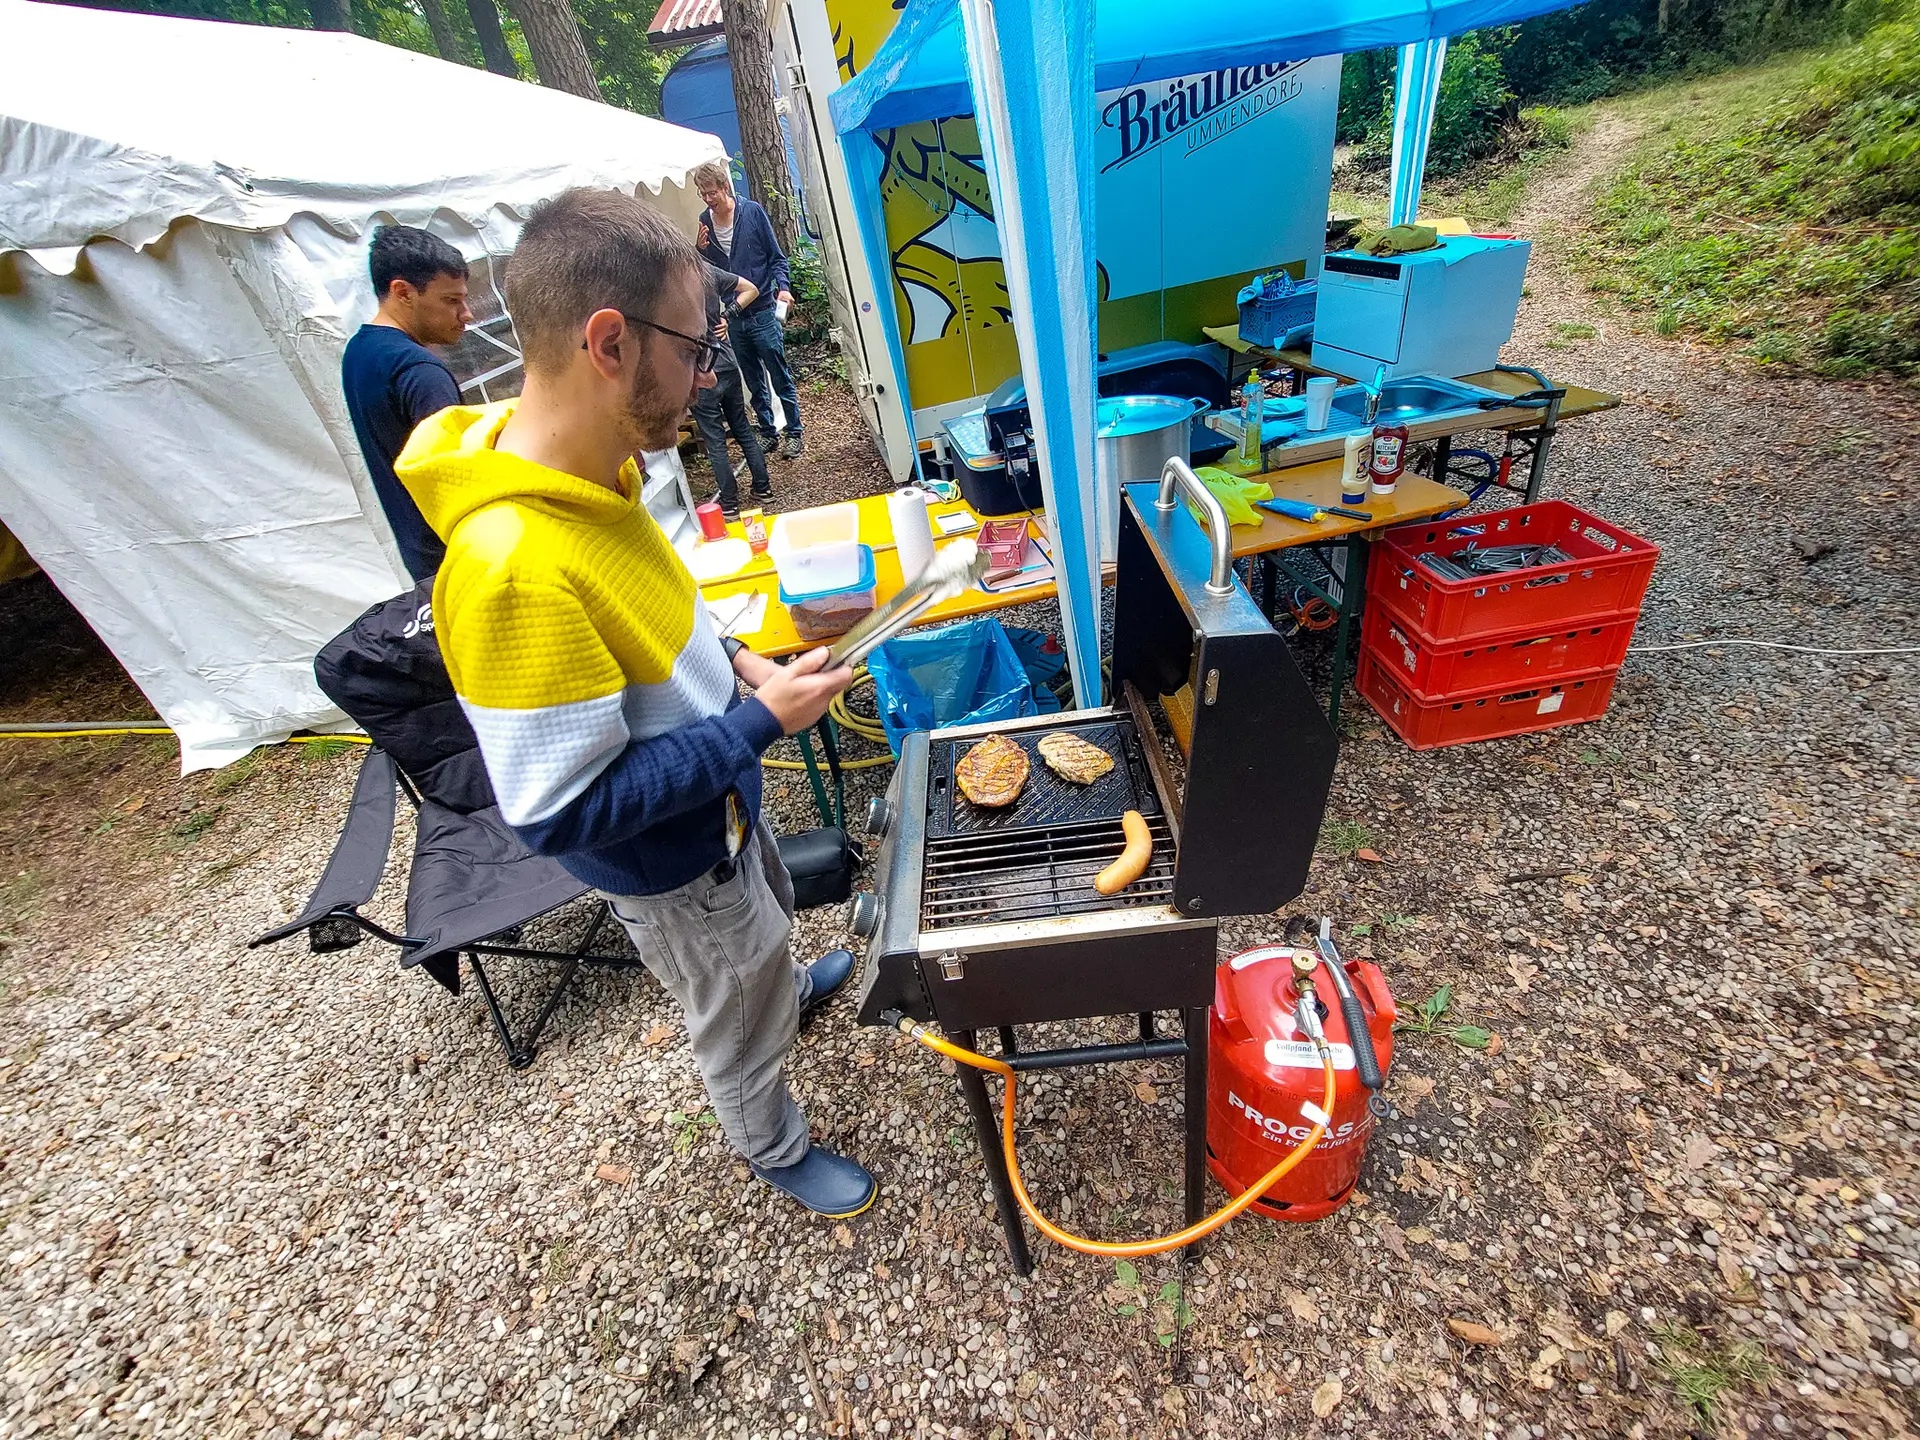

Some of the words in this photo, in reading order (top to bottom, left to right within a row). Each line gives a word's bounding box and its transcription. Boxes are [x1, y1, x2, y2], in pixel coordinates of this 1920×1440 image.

[1187, 74, 1298, 150] UMMENDORF
[1262, 1131, 1282, 1144] Ein
[1285, 1139, 1329, 1149] Frnd
